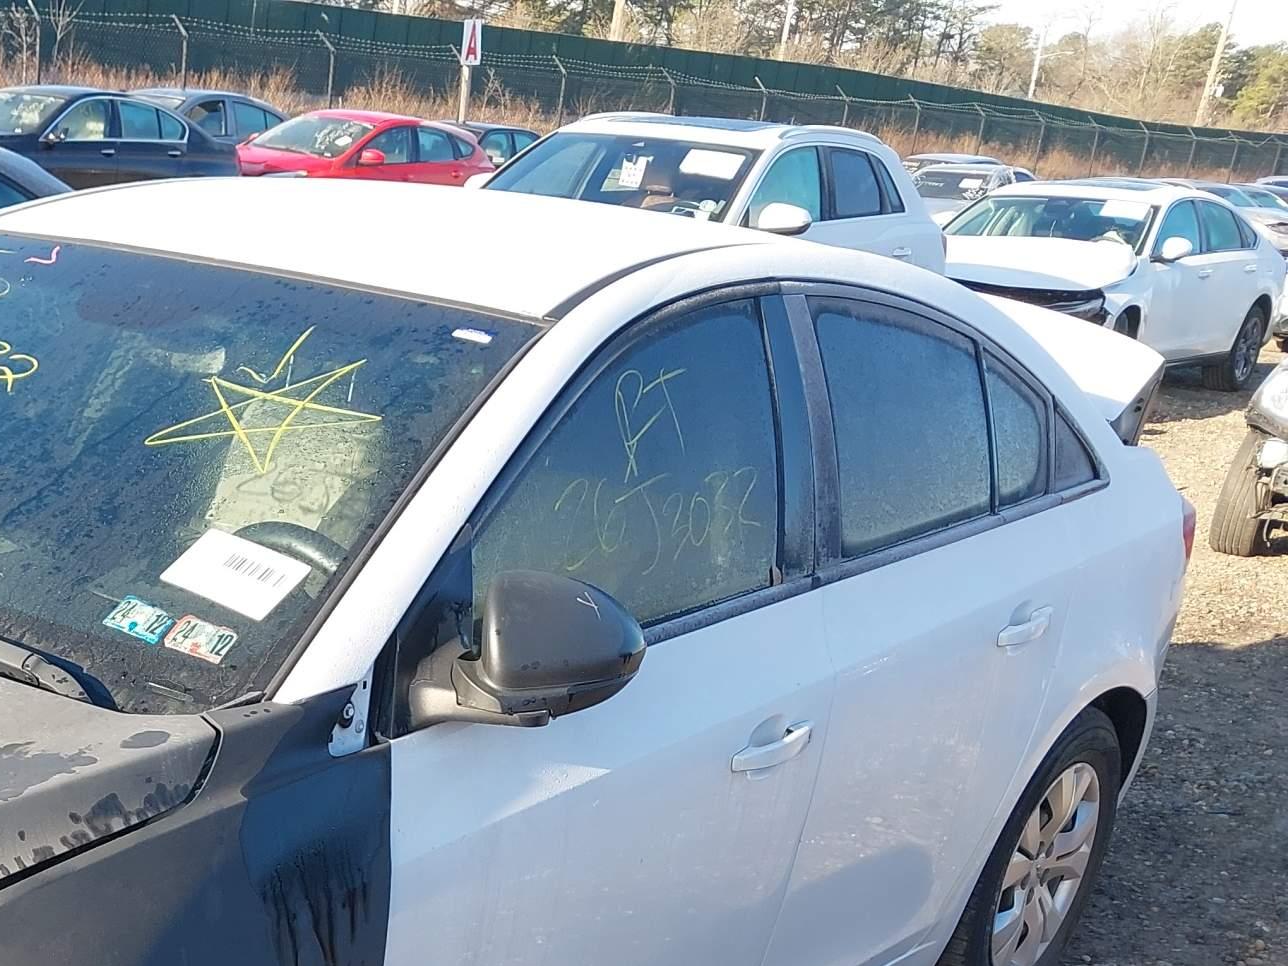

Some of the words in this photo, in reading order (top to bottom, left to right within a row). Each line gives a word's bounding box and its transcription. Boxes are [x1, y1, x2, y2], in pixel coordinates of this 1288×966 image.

[465, 20, 478, 61] A
[112, 600, 138, 622] 24
[144, 613, 169, 635] 12
[172, 620, 199, 644] 24
[209, 633, 234, 657] 12
